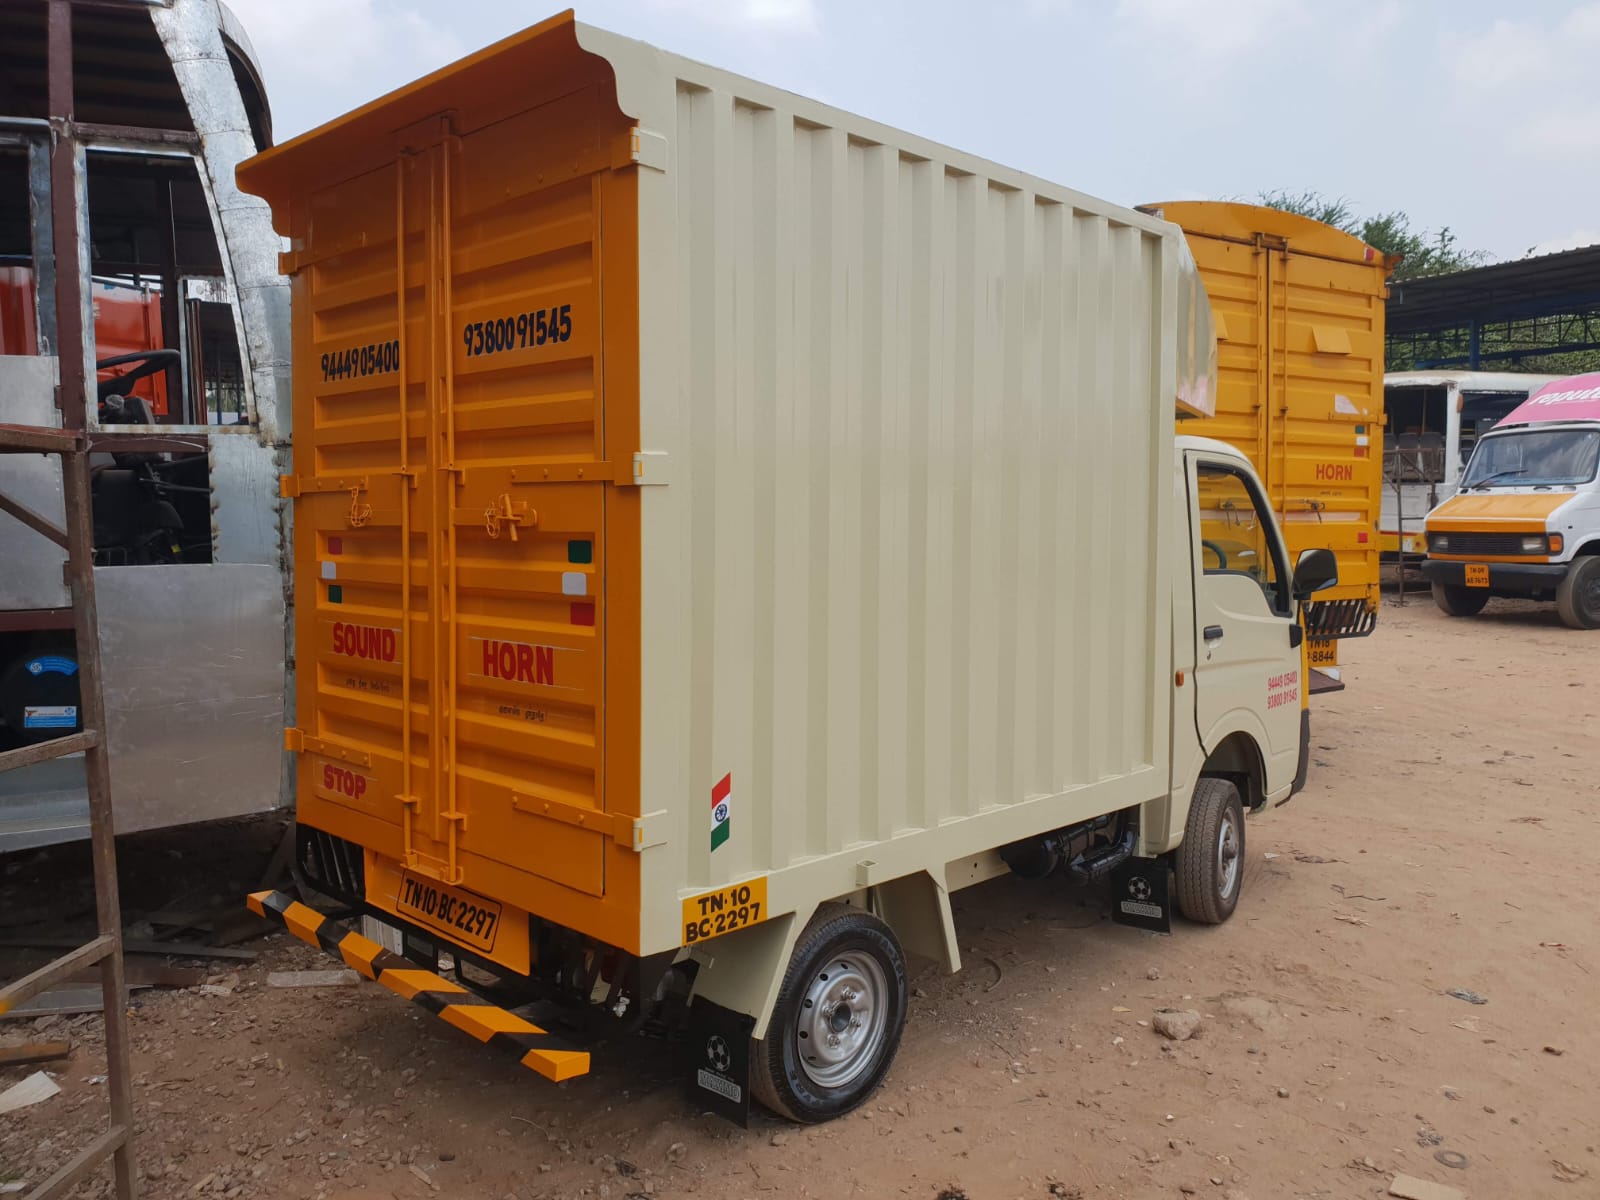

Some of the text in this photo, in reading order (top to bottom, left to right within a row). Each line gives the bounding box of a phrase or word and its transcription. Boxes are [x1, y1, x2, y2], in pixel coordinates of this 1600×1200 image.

[1315, 463, 1353, 480] HORN
[333, 622, 396, 663] SOUND
[482, 640, 554, 685] HORN
[323, 764, 366, 799] STOP
